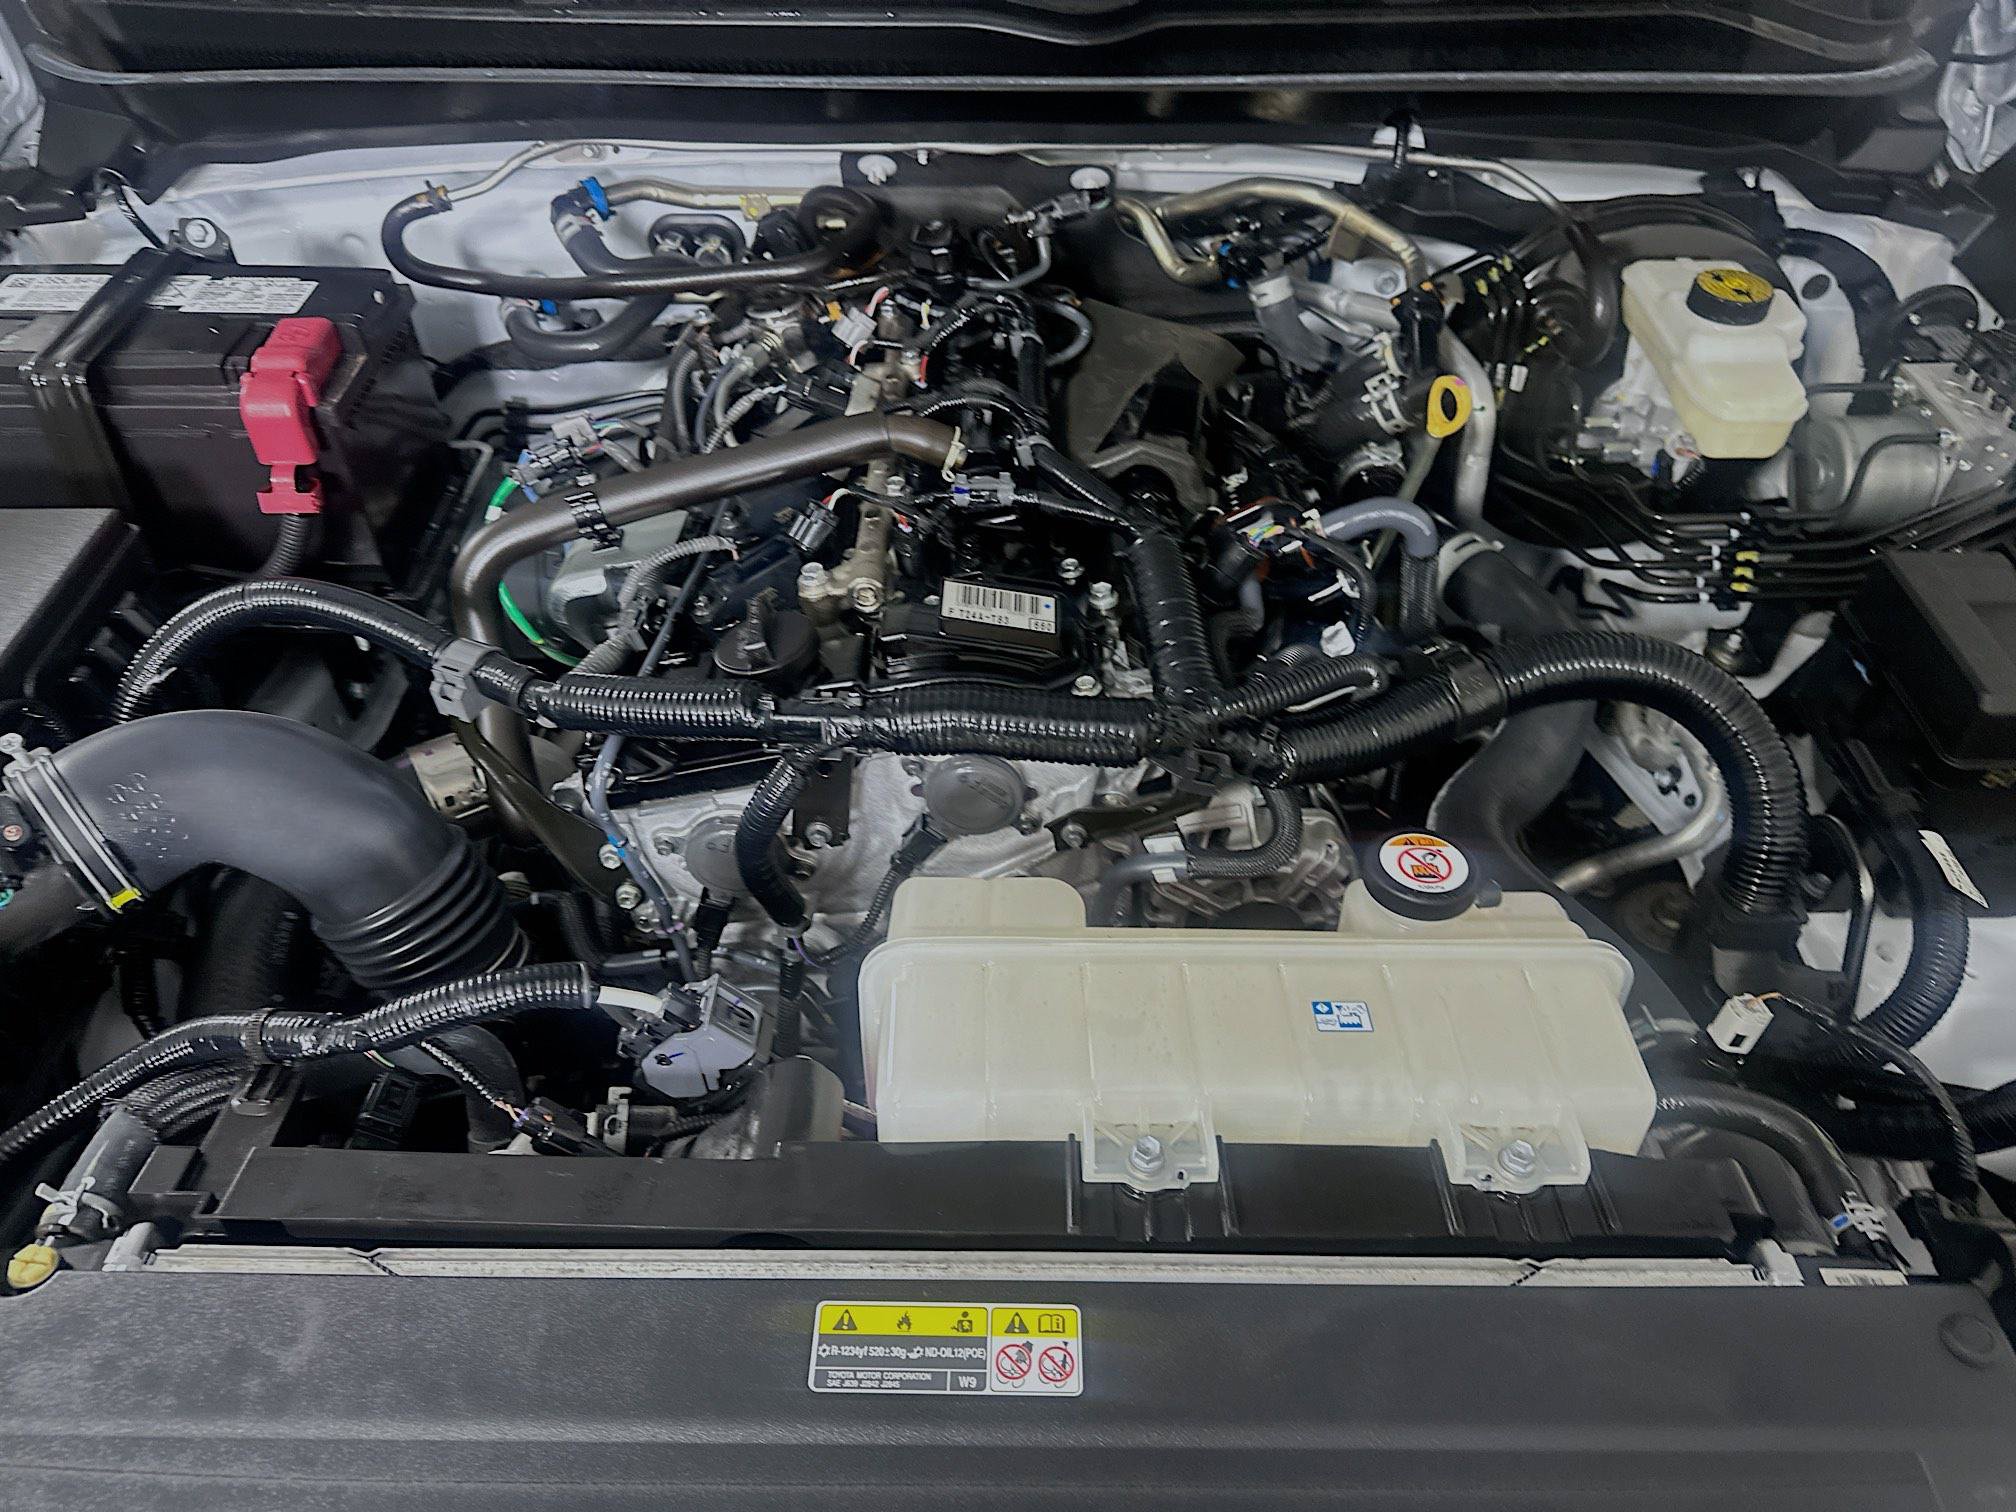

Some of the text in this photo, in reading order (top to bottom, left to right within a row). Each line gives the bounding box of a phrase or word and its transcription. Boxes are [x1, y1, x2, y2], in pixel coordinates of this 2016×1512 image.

[830, 1345, 867, 1358] R-1234yf
[827, 1371, 931, 1381] TOYOTA MOTOR CORPORATION
[827, 1379, 841, 1387] SAE
[958, 1376, 977, 1388] W9
